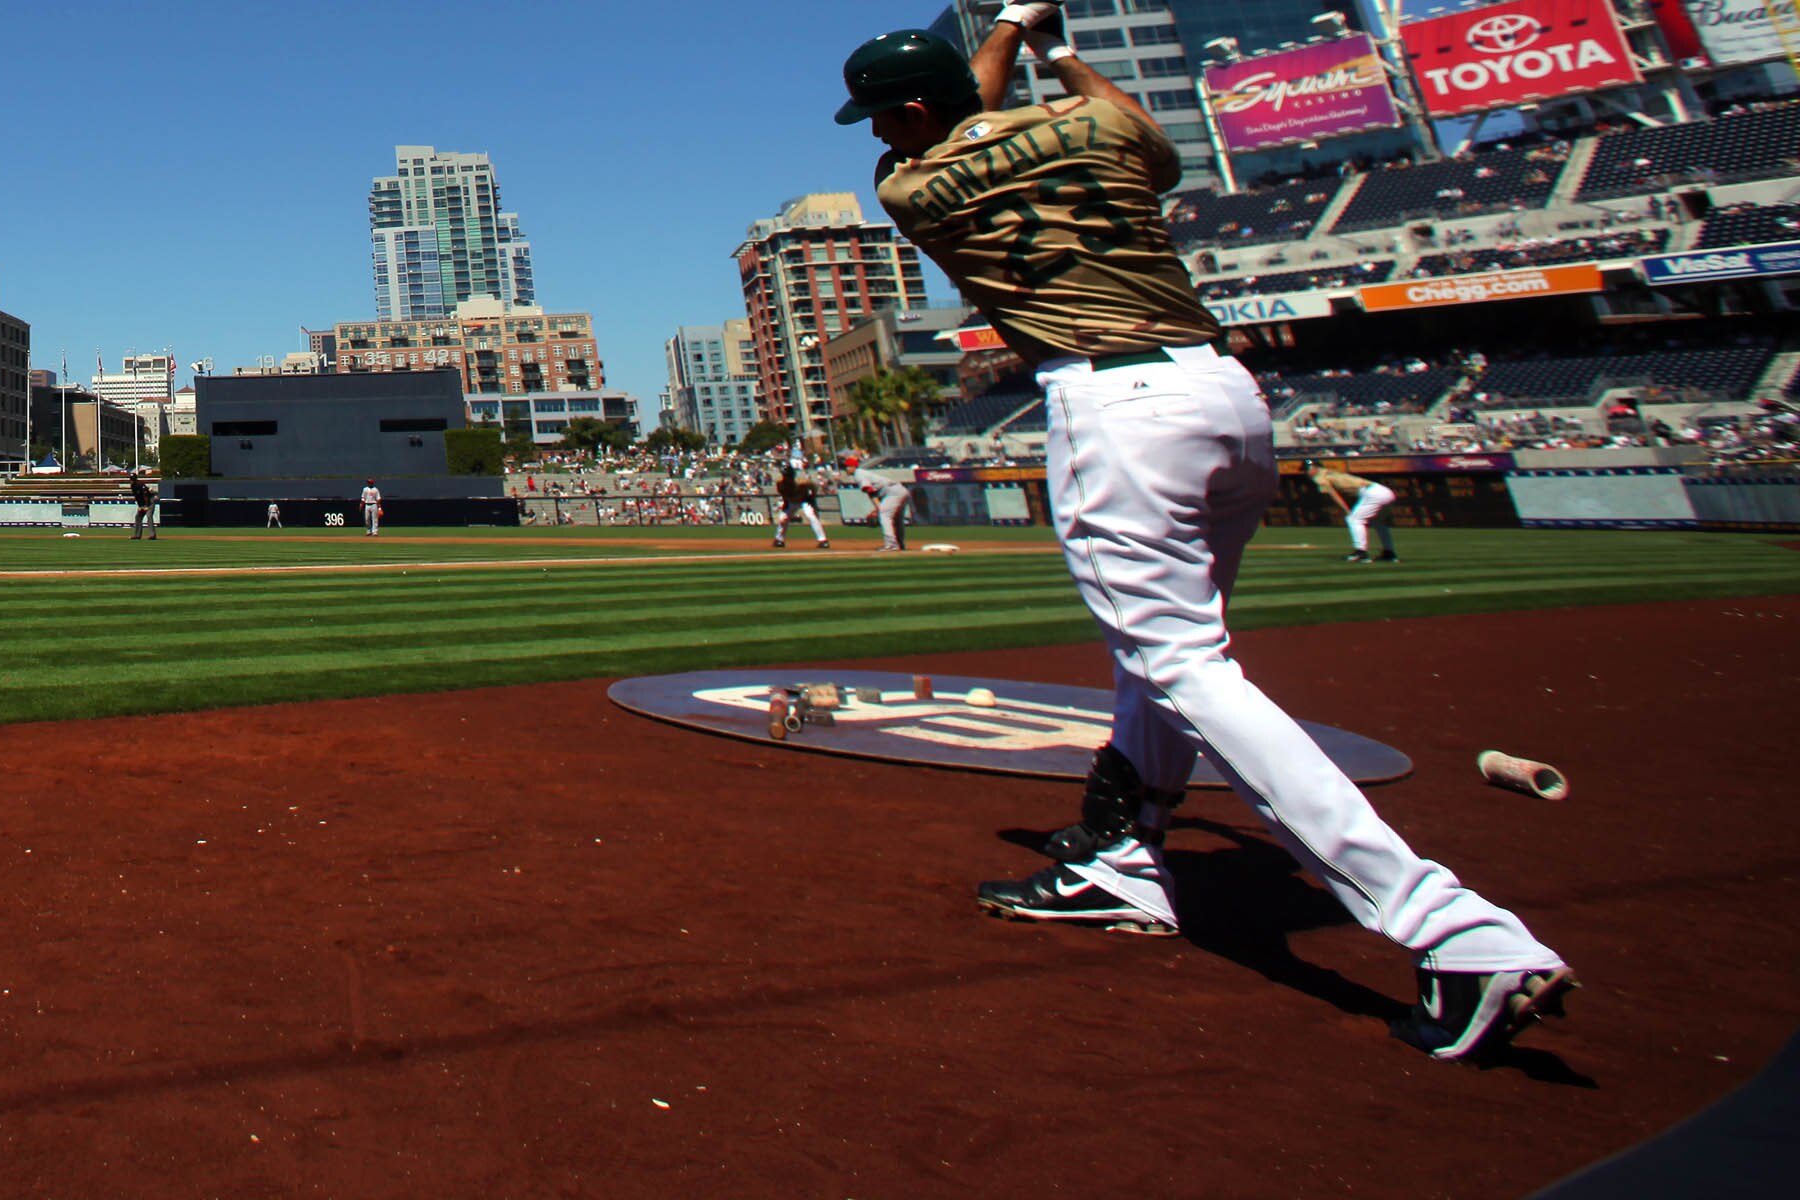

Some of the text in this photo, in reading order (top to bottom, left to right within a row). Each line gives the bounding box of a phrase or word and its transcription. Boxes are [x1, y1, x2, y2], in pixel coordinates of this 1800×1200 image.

[1424, 39, 1616, 96] TOYOTA
[909, 116, 1106, 221] GONZALEZ
[1406, 277, 1549, 302] Chegg.com
[1207, 298, 1298, 323] OKIA
[202, 356, 213, 371] 6
[256, 354, 275, 368] 19
[364, 351, 387, 366] 35
[425, 349, 449, 366] 42
[324, 512, 344, 526] 396
[740, 511, 764, 525] 400
